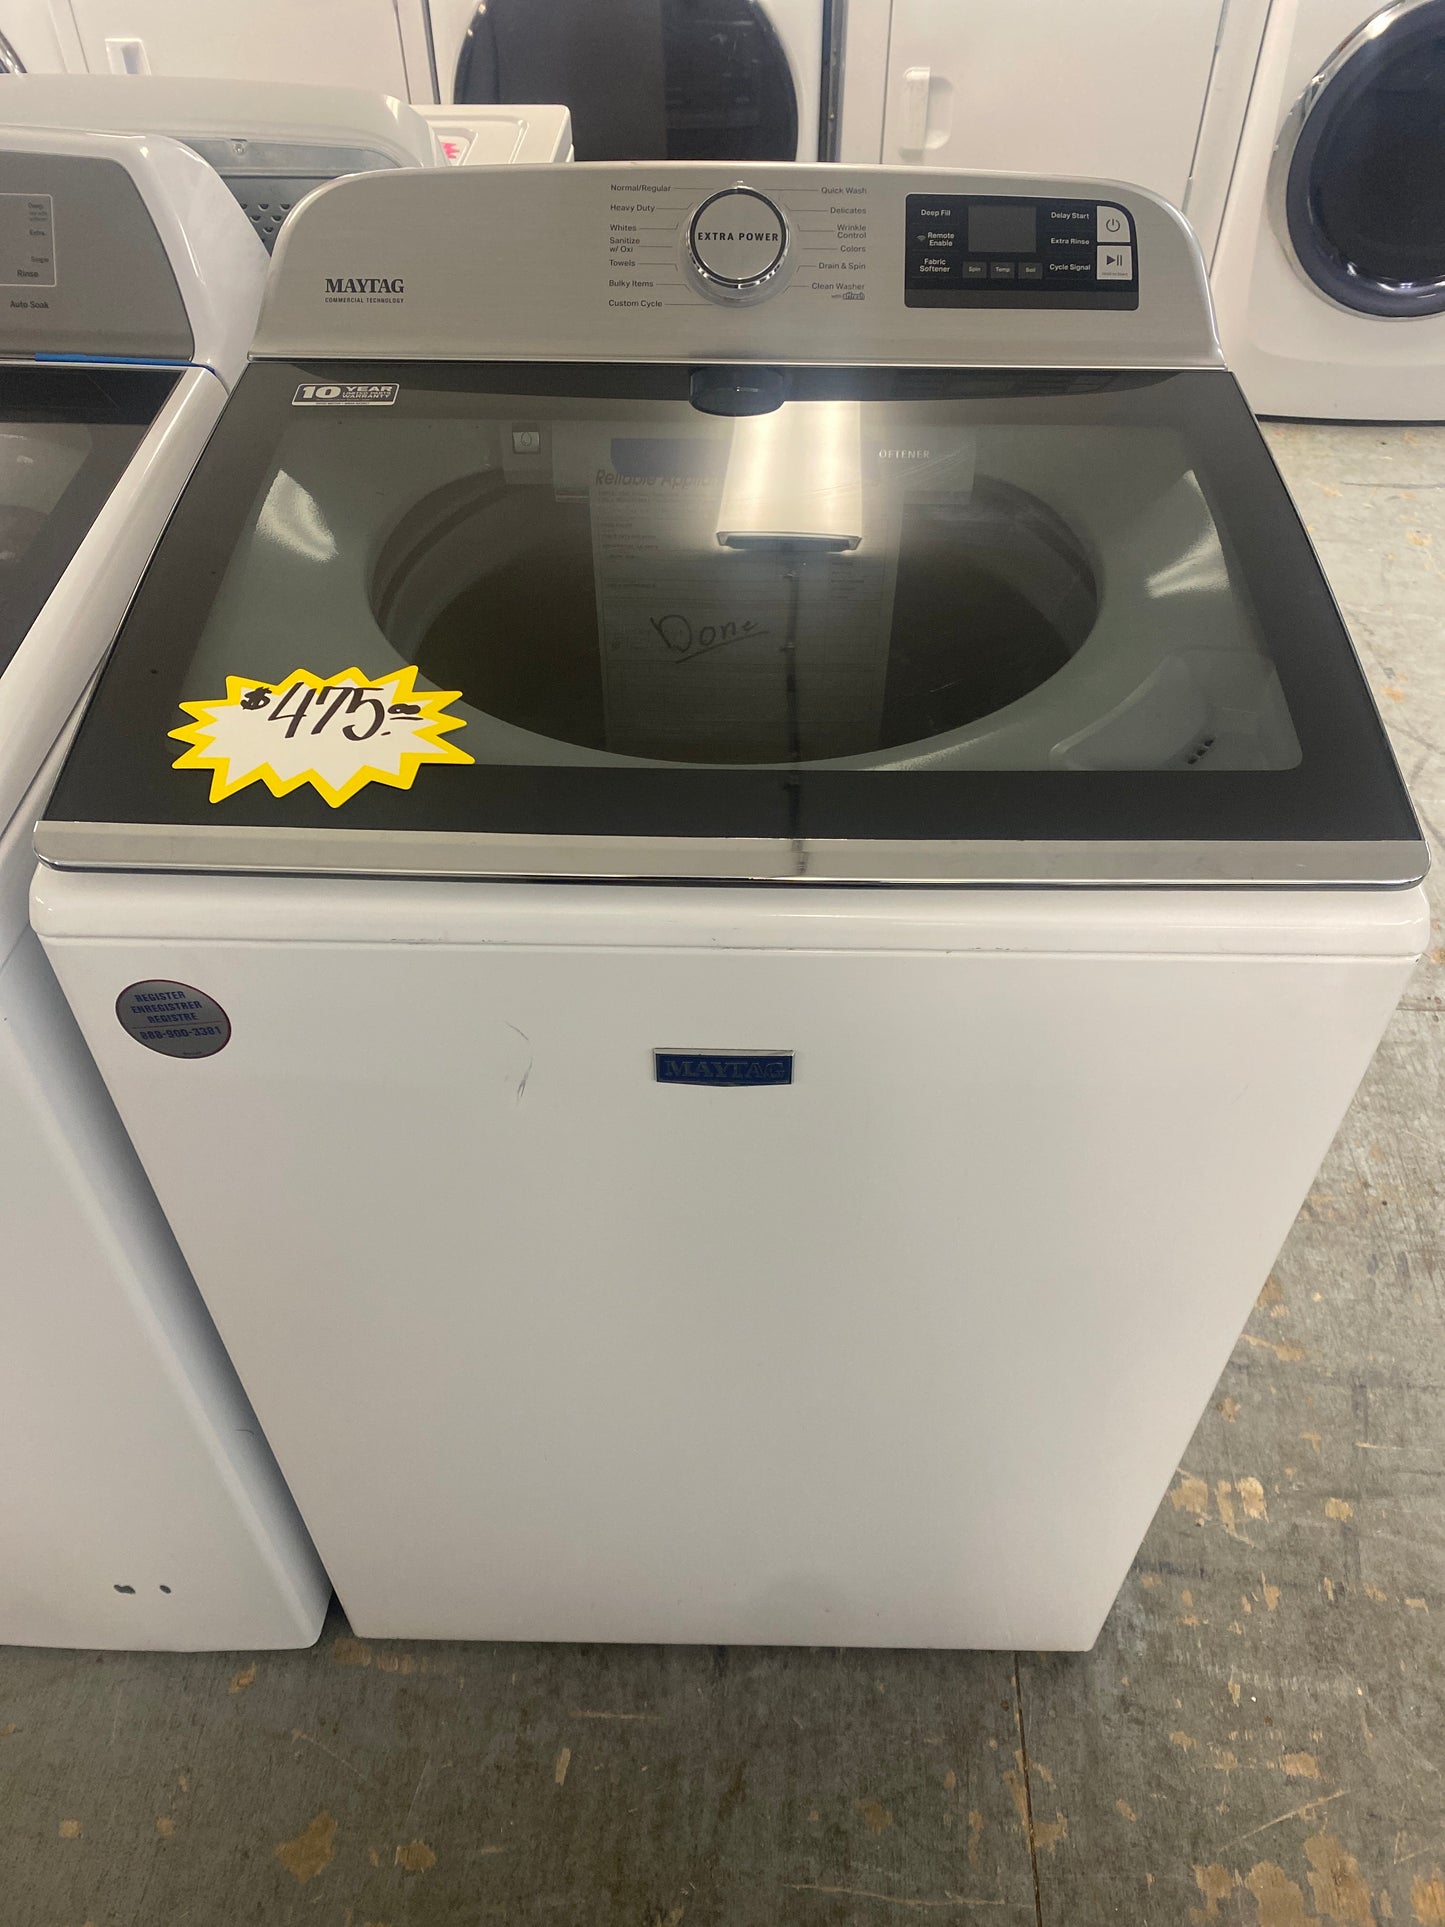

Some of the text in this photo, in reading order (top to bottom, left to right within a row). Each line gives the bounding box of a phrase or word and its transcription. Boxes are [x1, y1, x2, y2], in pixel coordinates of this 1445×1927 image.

[610, 184, 671, 193] Normal/Regular
[821, 186, 843, 194] Quick
[610, 203, 656, 213] Heavy Duty
[830, 206, 867, 214] Delicates
[920, 209, 940, 217] Deep
[1051, 211, 1070, 220] Delay
[609, 223, 637, 232] Whites
[836, 223, 867, 231] Wrinkle
[698, 232, 779, 242] EXTRA POWER
[837, 231, 867, 239] Control
[927, 231, 955, 239] Remote
[609, 236, 641, 245] Sanitize
[929, 239, 953, 247] Enable
[1050, 237, 1069, 245] Extra
[840, 244, 867, 252] Colors
[609, 259, 636, 267] Towels
[841, 262, 847, 270] &
[848, 262, 866, 271] Spin
[1049, 263, 1090, 272] Cycle Signal
[17, 269, 39, 278] Rinse
[919, 265, 950, 273] Softener
[325, 278, 404, 294] MAYTAG
[608, 279, 631, 288] Bulky
[811, 282, 865, 290] Clean Washer
[10, 300, 49, 309] Auto Soak
[608, 299, 663, 308] Custom Cycle
[302, 385, 341, 399] 10
[595, 468, 657, 486] Reliable
[649, 613, 759, 653] Done
[134, 990, 186, 1003] REGISTER
[131, 1000, 203, 1014] ENREGISTRER
[147, 1012, 199, 1024] REGISTRE
[663, 1060, 786, 1079] MAYTAG
